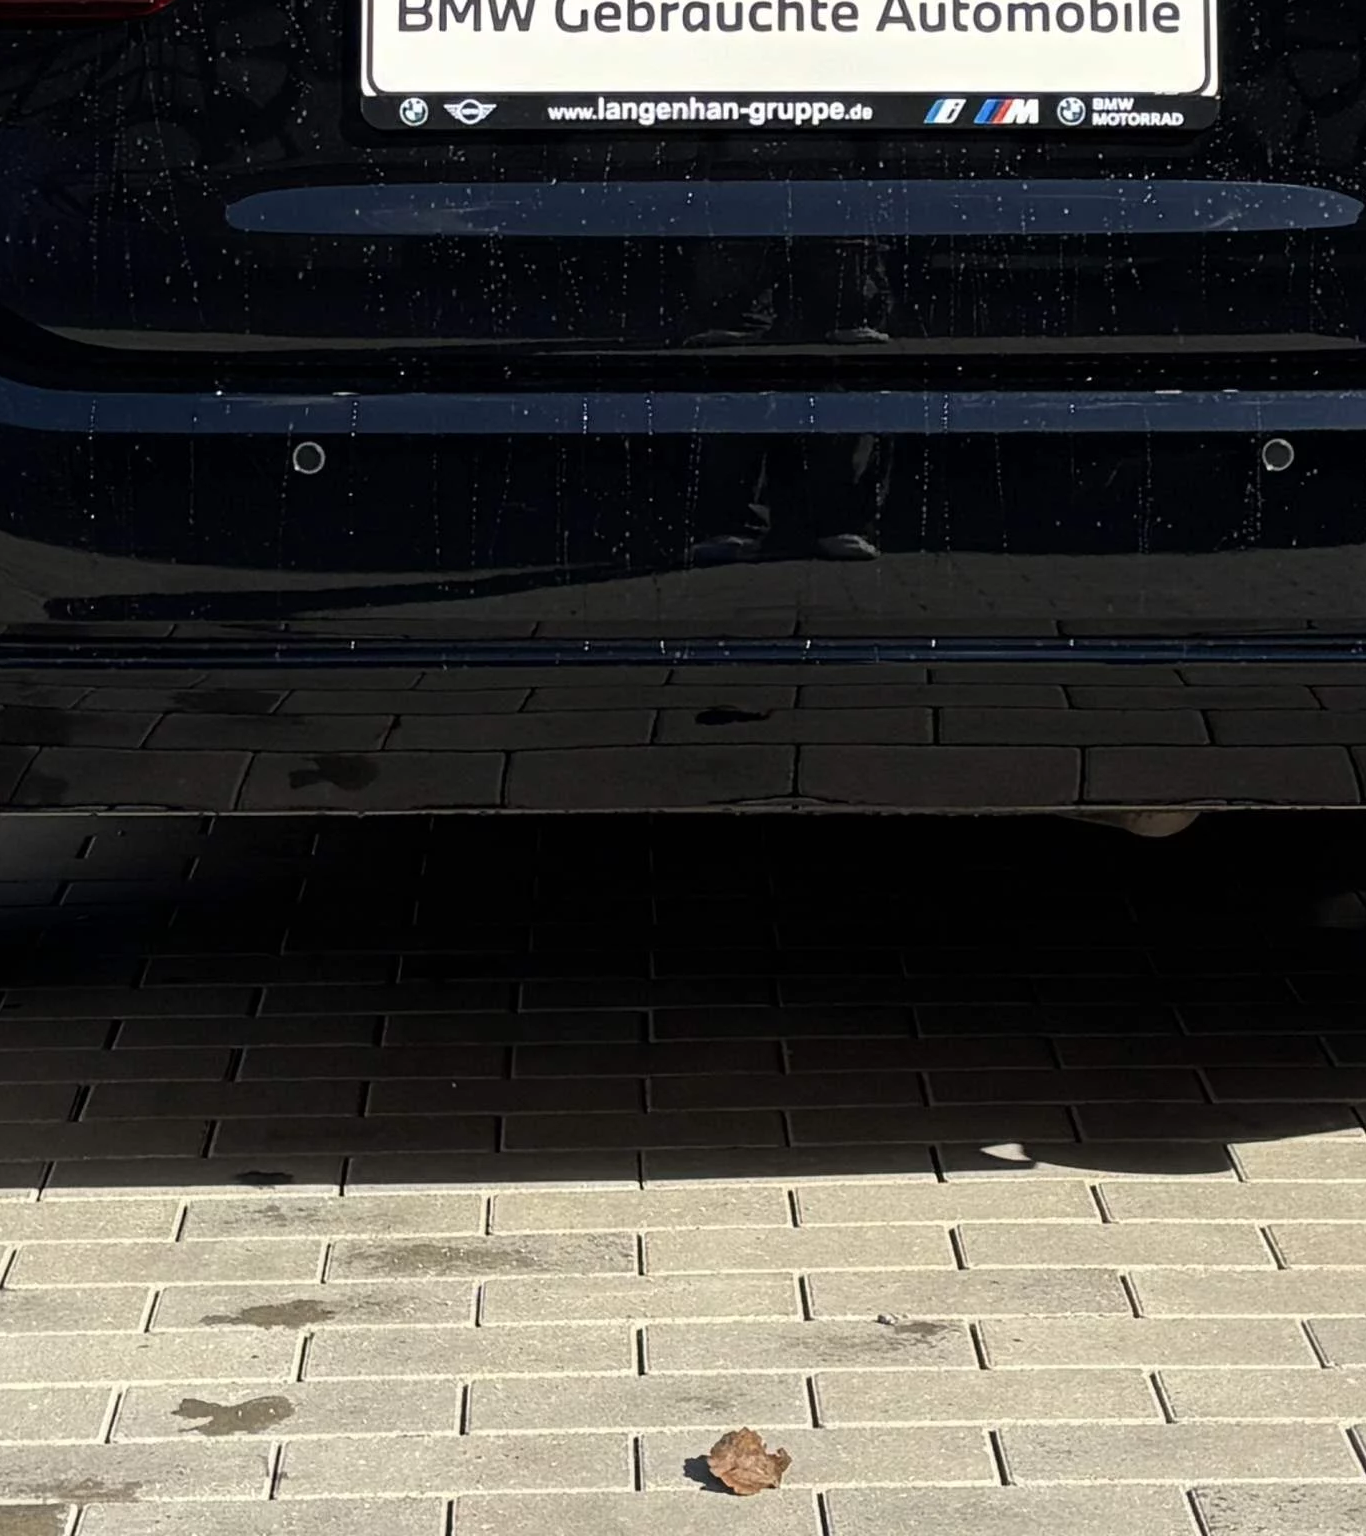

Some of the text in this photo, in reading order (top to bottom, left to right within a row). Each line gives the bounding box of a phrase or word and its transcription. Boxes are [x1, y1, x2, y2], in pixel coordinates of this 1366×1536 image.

[547, 96, 873, 126] www.langenhan-gruppe.de
[1092, 97, 1135, 111] BMW
[1092, 112, 1185, 127] MOTORRAD
